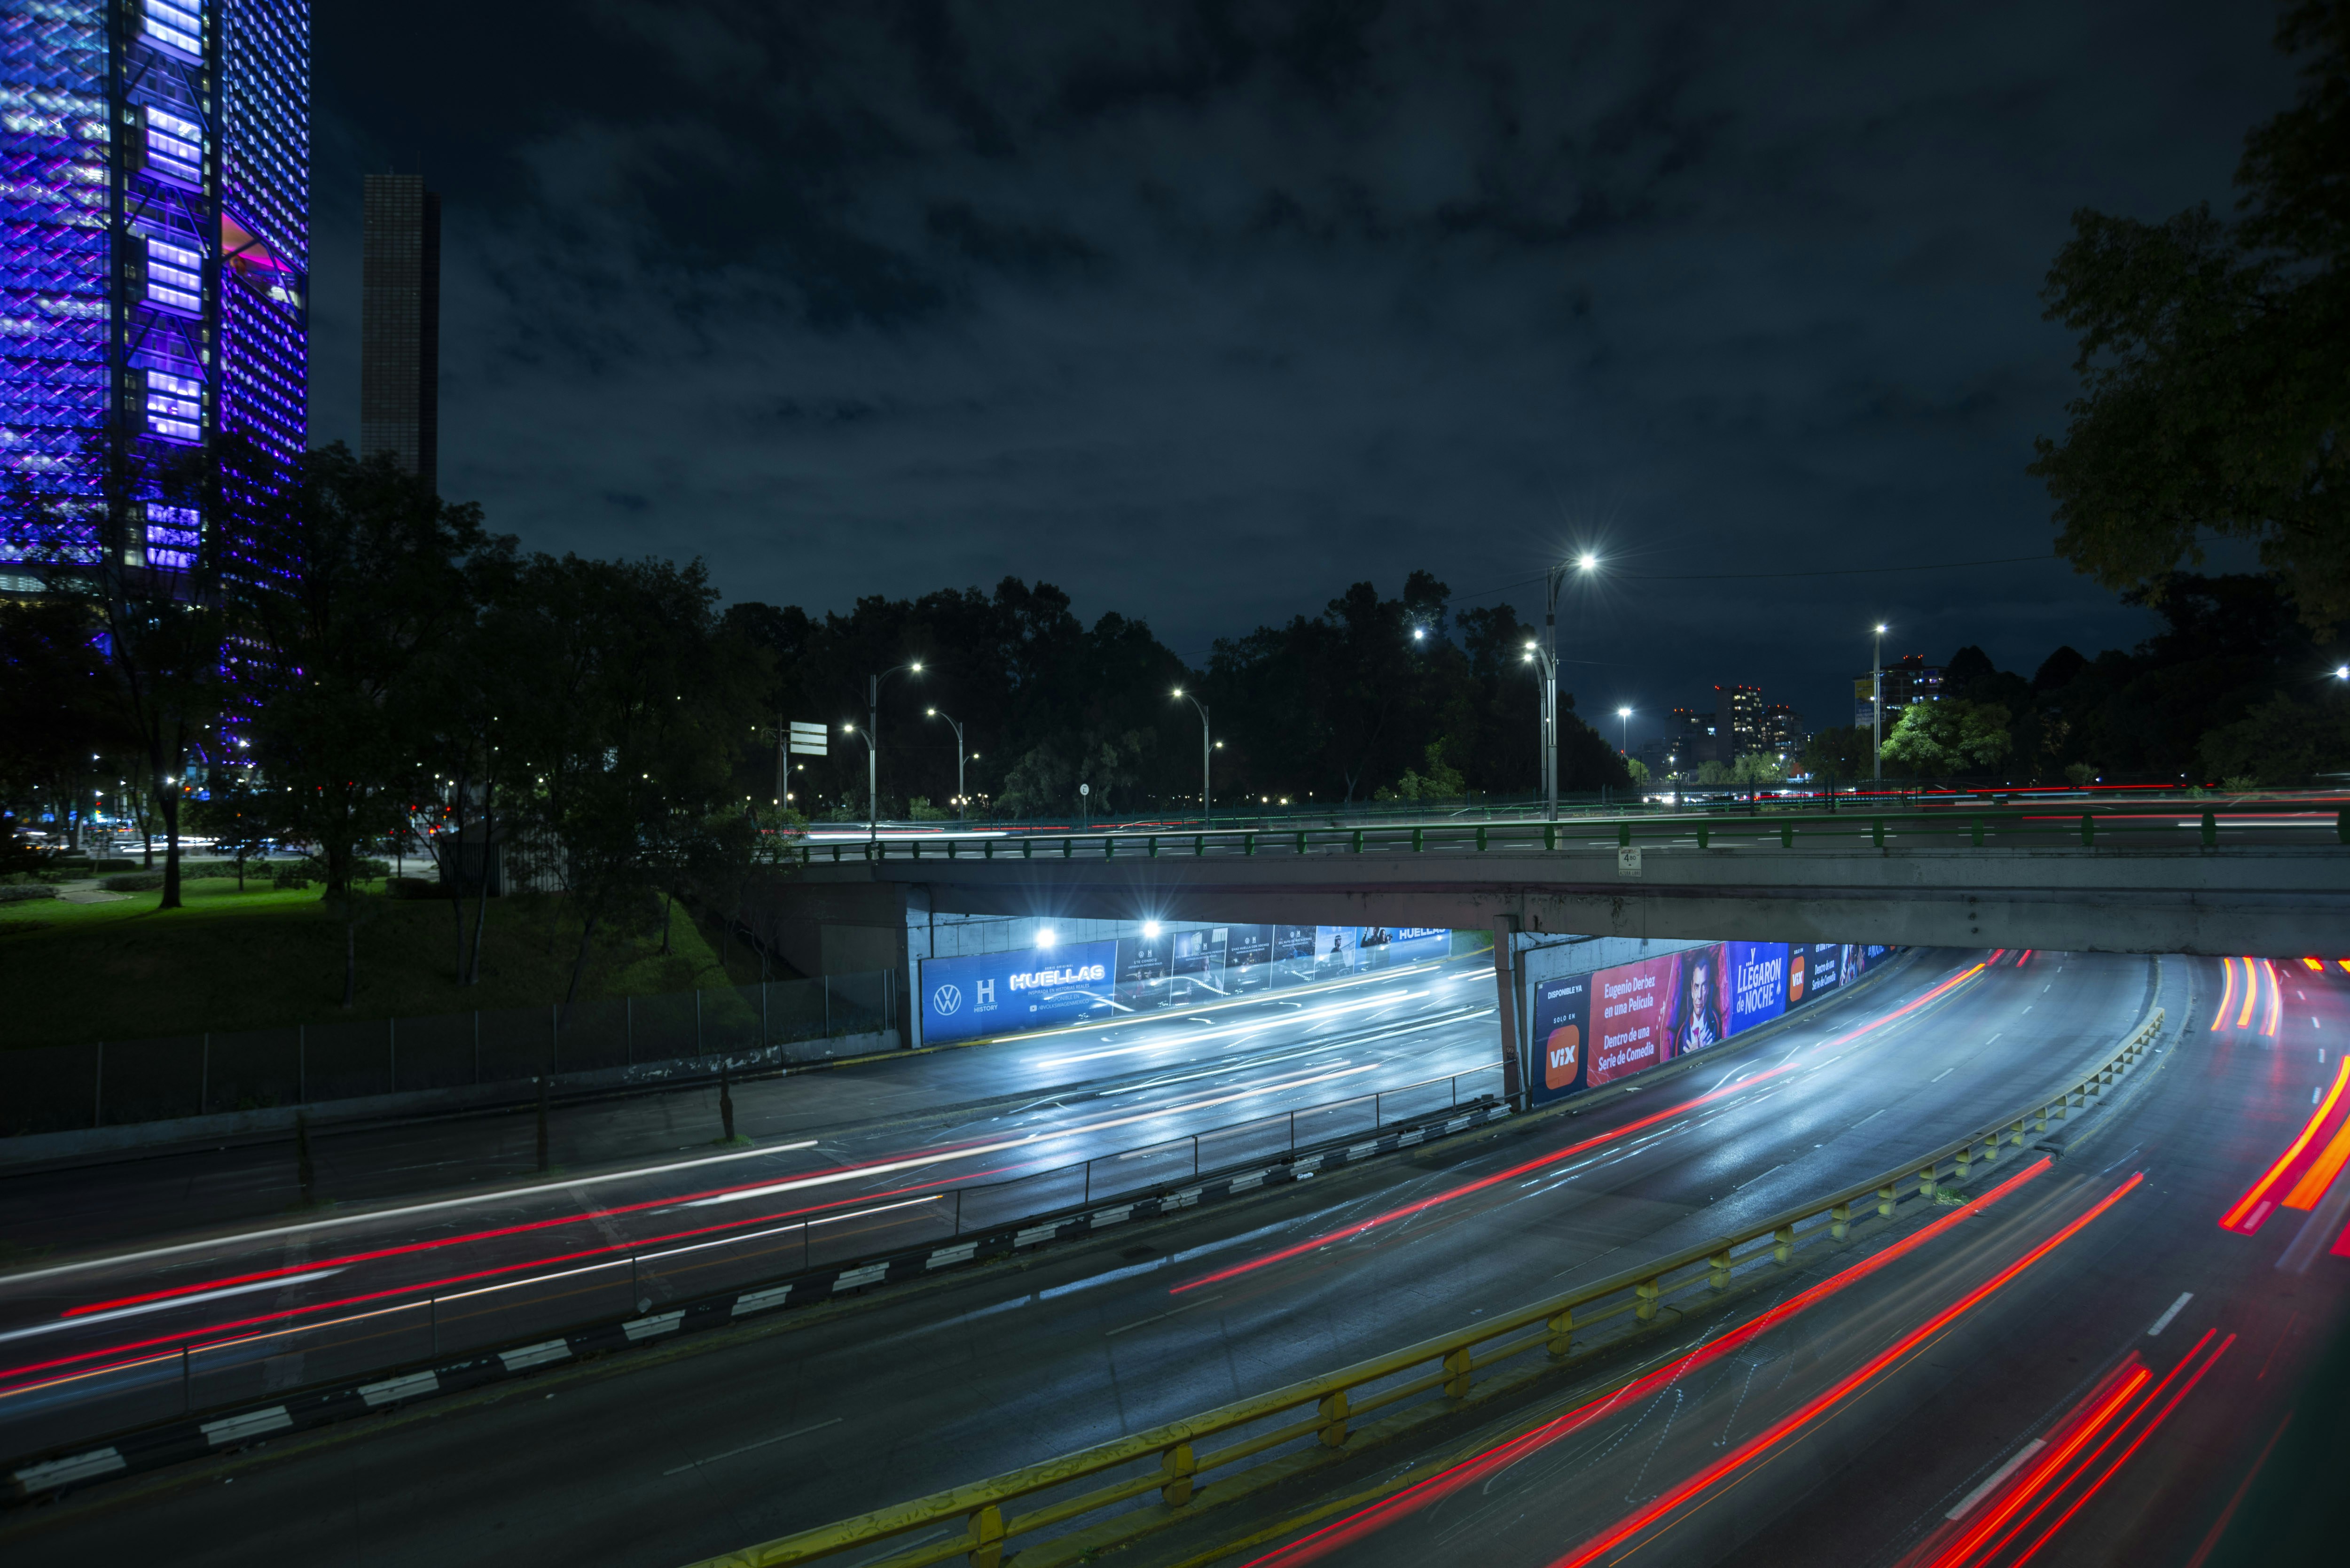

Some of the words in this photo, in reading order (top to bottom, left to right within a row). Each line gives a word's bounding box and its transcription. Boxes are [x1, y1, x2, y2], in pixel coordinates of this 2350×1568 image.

[1010, 965, 1105, 990] HUELLAS
[1737, 958, 1781, 994] LLEGARON
[1792, 971, 1803, 987] ViX
[1815, 964, 1825, 975] Dentro
[1825, 960, 1829, 970] de
[1820, 976, 1824, 987] de
[1824, 971, 1836, 985] Comedia
[1548, 986, 1575, 999] DISPONIBLE
[1575, 985, 1582, 993] YA
[1604, 979, 1631, 999] Eugenio
[1633, 974, 1655, 991] Derbez
[974, 1005, 998, 1013] HISTORY
[1604, 1006, 1613, 1018] en
[1614, 1003, 1627, 1015] una
[1629, 993, 1653, 1012] Película
[1737, 996, 1744, 1013] de
[1745, 983, 1774, 1015] NOCHE
[1554, 1015, 1566, 1024] SOLO
[1604, 1033, 1627, 1050] Dentro
[1629, 1027, 1636, 1042] de
[1638, 1026, 1650, 1039] una
[1550, 1045, 1576, 1068] ViX
[1598, 1053, 1616, 1071] Serie
[1617, 1050, 1625, 1064] de
[1626, 1042, 1654, 1062] Comedia
